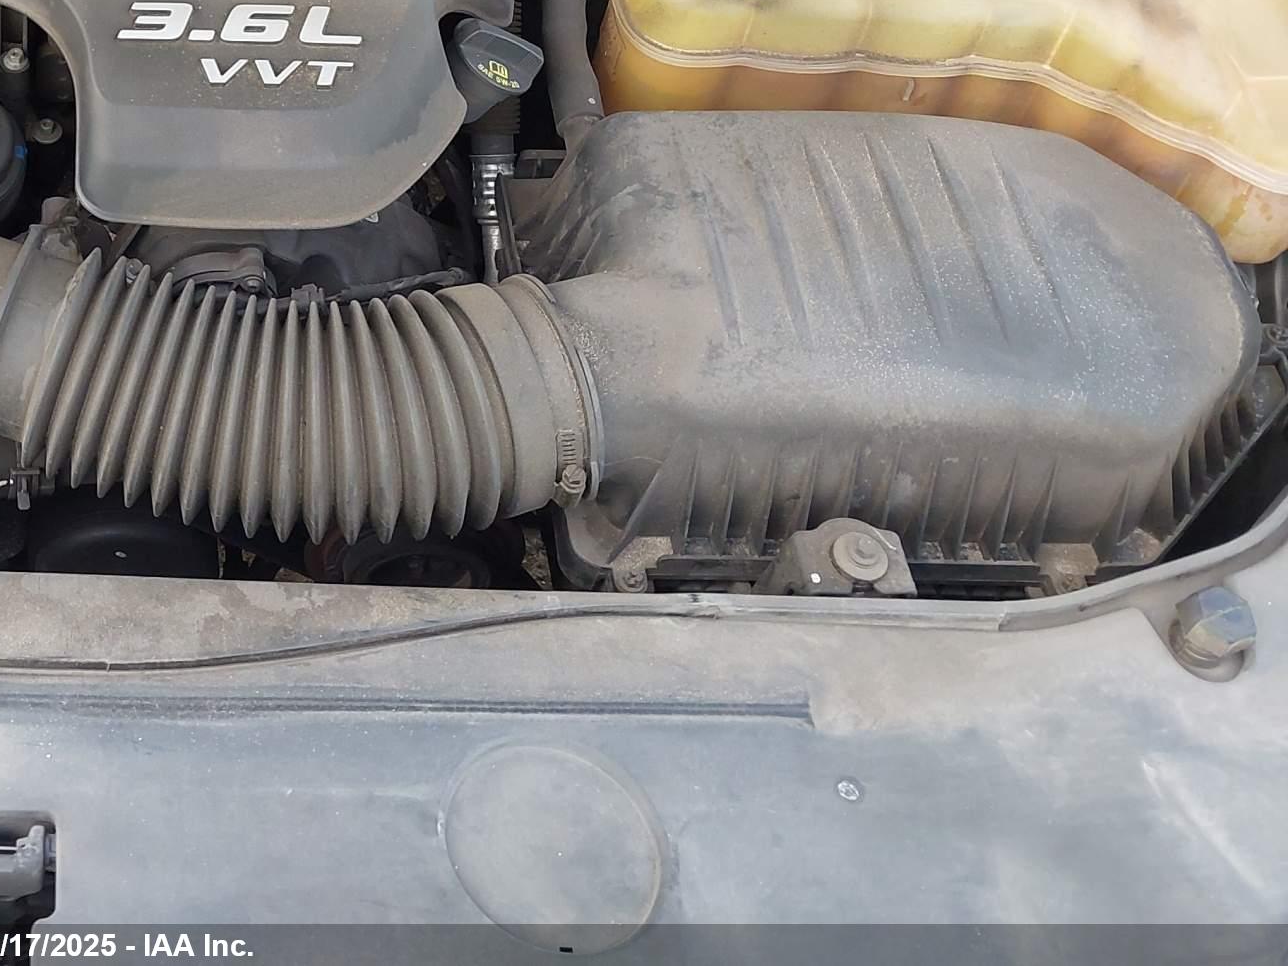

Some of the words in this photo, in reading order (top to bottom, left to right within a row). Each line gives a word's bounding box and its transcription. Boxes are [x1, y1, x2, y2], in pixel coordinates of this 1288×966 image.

[117, 2, 362, 45] 3.6L
[200, 58, 354, 87] VVT
[477, 63, 494, 79] SAE
[495, 76, 520, 89] 5W-20
